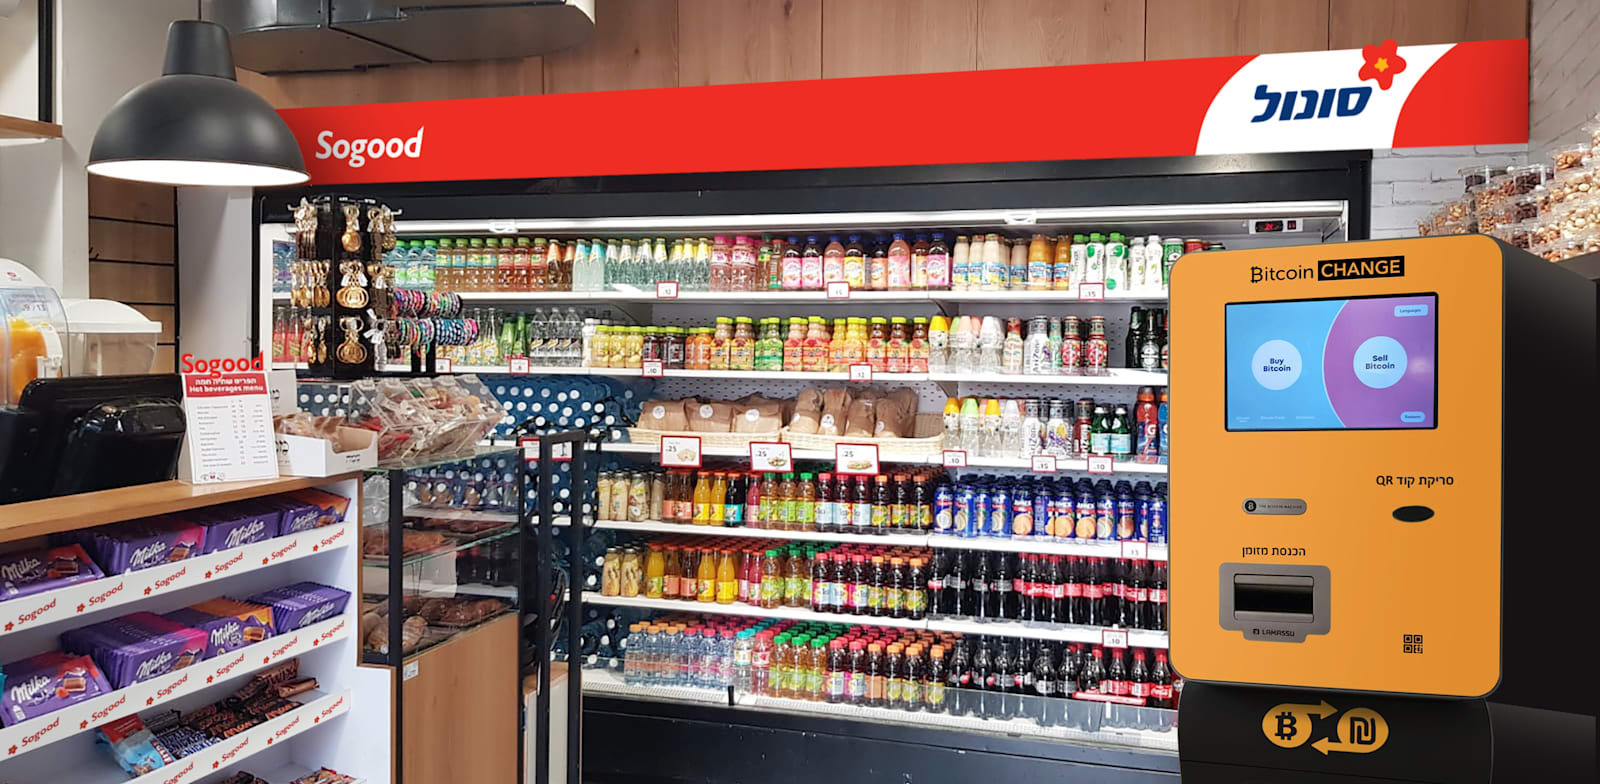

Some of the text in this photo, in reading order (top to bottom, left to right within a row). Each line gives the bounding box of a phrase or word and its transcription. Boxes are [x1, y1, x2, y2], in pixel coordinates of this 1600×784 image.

[1250, 84, 1373, 123] סונול
[315, 125, 424, 168] Sogood
[1320, 259, 1401, 279] CHANGE
[181, 351, 264, 379] Sogood
[1263, 365, 1291, 373] Bitcoin
[1269, 358, 1285, 367] Buy
[1365, 362, 1395, 371] Bitcoin
[1372, 354, 1389, 362] Sell
[204, 384, 241, 394] beverages
[1375, 475, 1454, 489] סריקת קוד QR
[225, 518, 265, 547] Milka
[320, 529, 345, 548] Sogood
[129, 541, 167, 567] Milka
[271, 540, 297, 560] Sogood
[1242, 546, 1306, 558] הכנסת מזומן
[1, 558, 41, 581] Milka
[215, 552, 244, 574] Sogood
[155, 568, 186, 590] Sogood
[89, 582, 124, 607] Sogood
[18, 598, 57, 625] Sogood
[211, 621, 241, 647] Milka
[321, 620, 345, 641] Sogood
[1261, 629, 1295, 637] LAMASSU
[272, 636, 298, 658] Sogood
[136, 651, 172, 678] Milka
[216, 653, 245, 678] Sogood
[11, 675, 51, 704] Milka
[157, 674, 188, 699] Sogood
[92, 695, 126, 722] Sogood
[322, 697, 344, 718] Sogood
[22, 717, 60, 747] Sogood
[276, 715, 300, 739] Sogood
[222, 736, 249, 763] Sogood
[163, 760, 194, 784] Sogood
